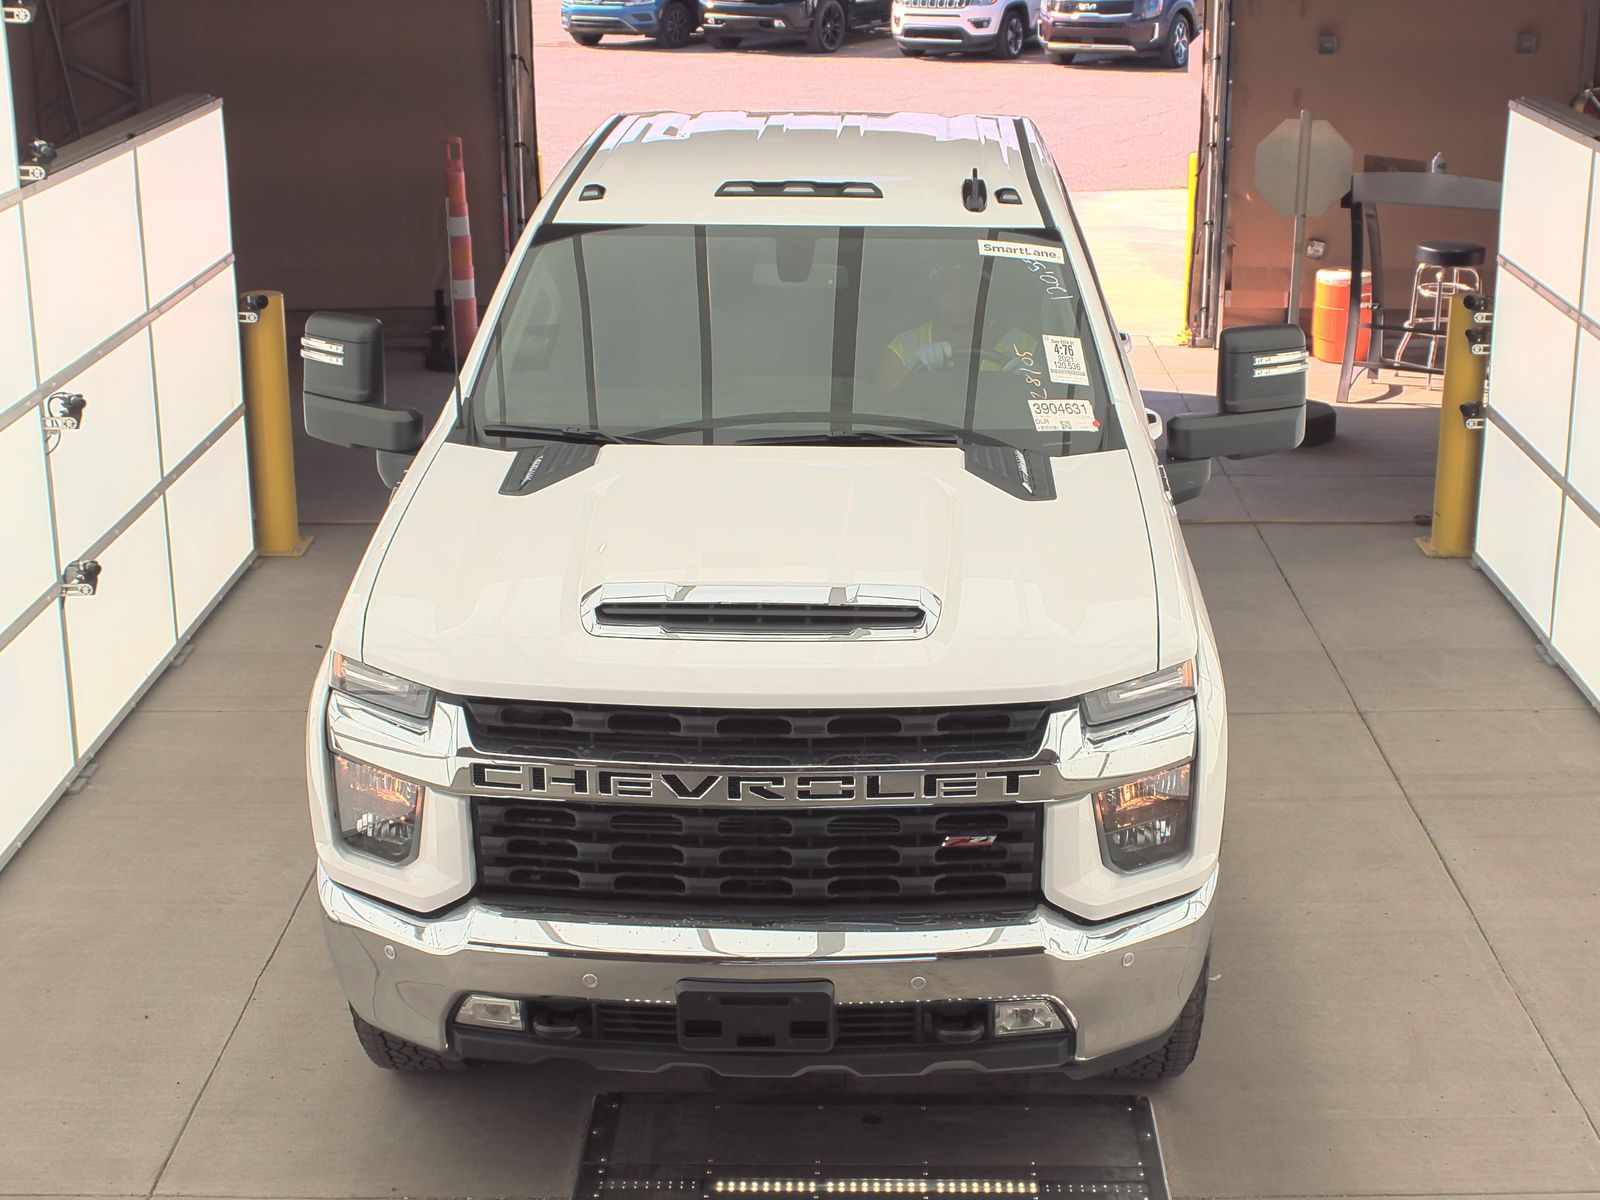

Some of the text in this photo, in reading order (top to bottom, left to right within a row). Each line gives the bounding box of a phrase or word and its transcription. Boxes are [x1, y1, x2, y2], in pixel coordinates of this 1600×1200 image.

[983, 243, 1057, 259] SmartLane
[1054, 344, 1074, 357] 4:76
[1057, 355, 1074, 363] 2021
[1032, 402, 1088, 415] 3904631
[471, 763, 1041, 801] CHEVROLET
